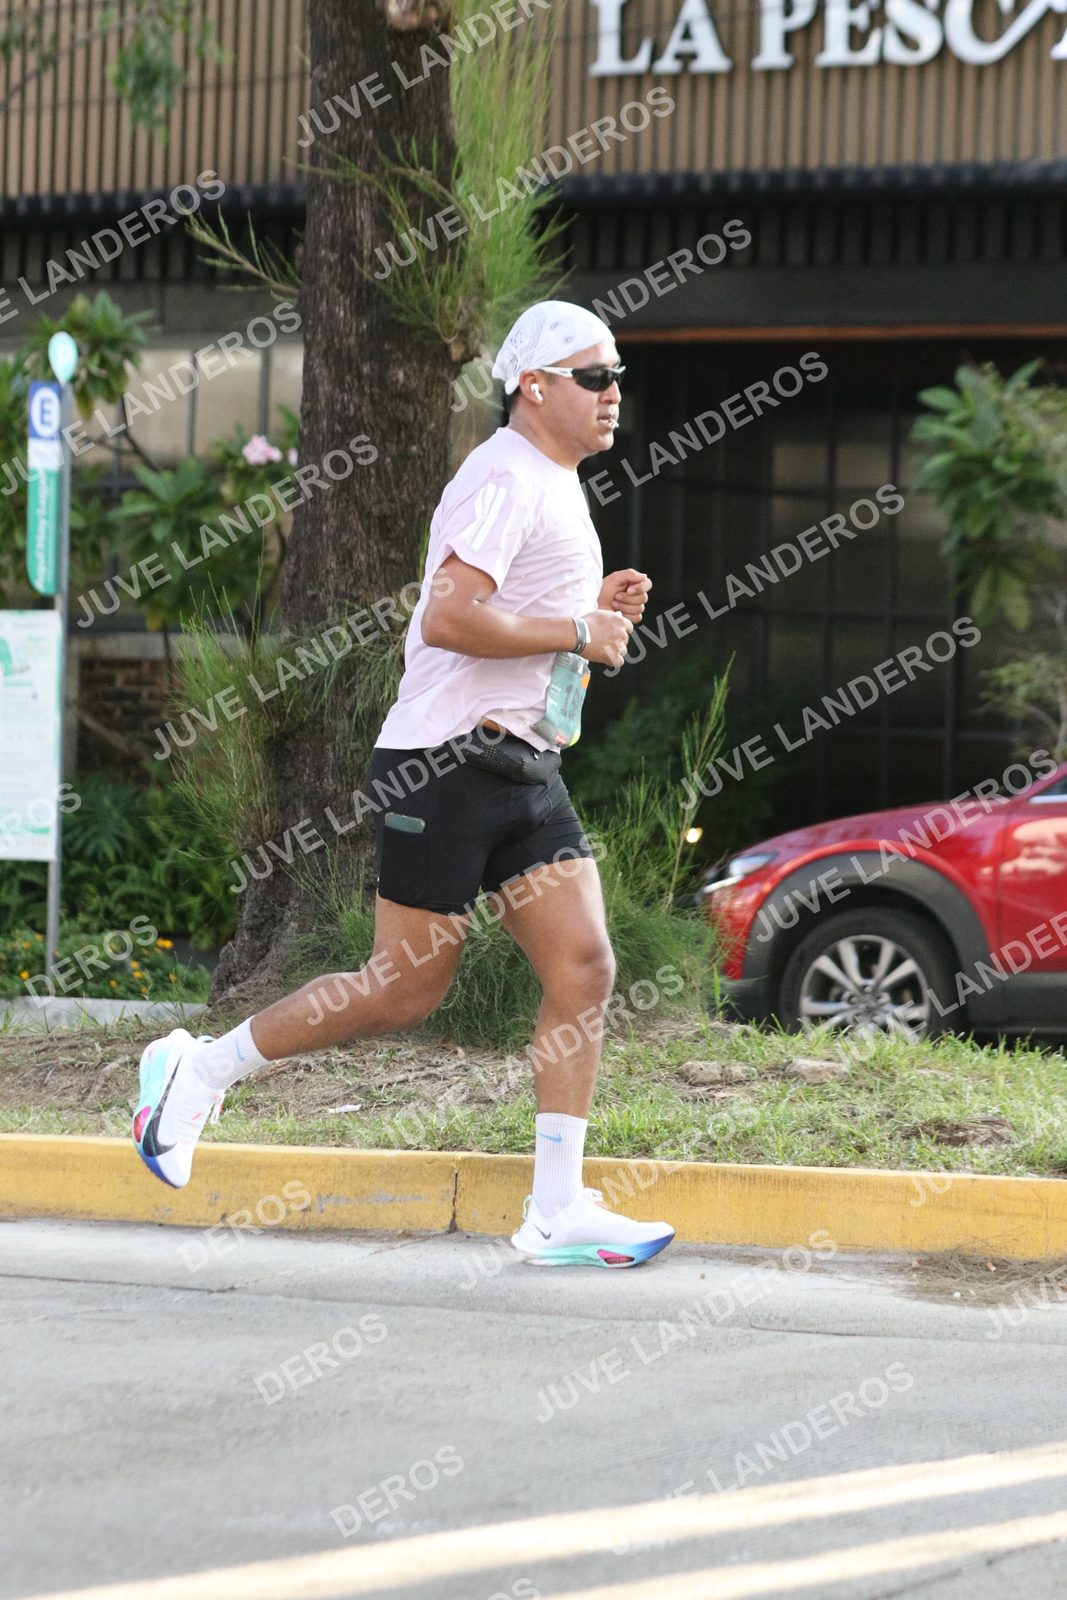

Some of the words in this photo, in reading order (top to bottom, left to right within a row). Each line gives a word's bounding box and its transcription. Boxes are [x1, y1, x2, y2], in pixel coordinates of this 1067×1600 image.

[588, 0, 732, 76] LA
[751, 0, 1067, 71] PESC
[40, 399, 52, 426] E
